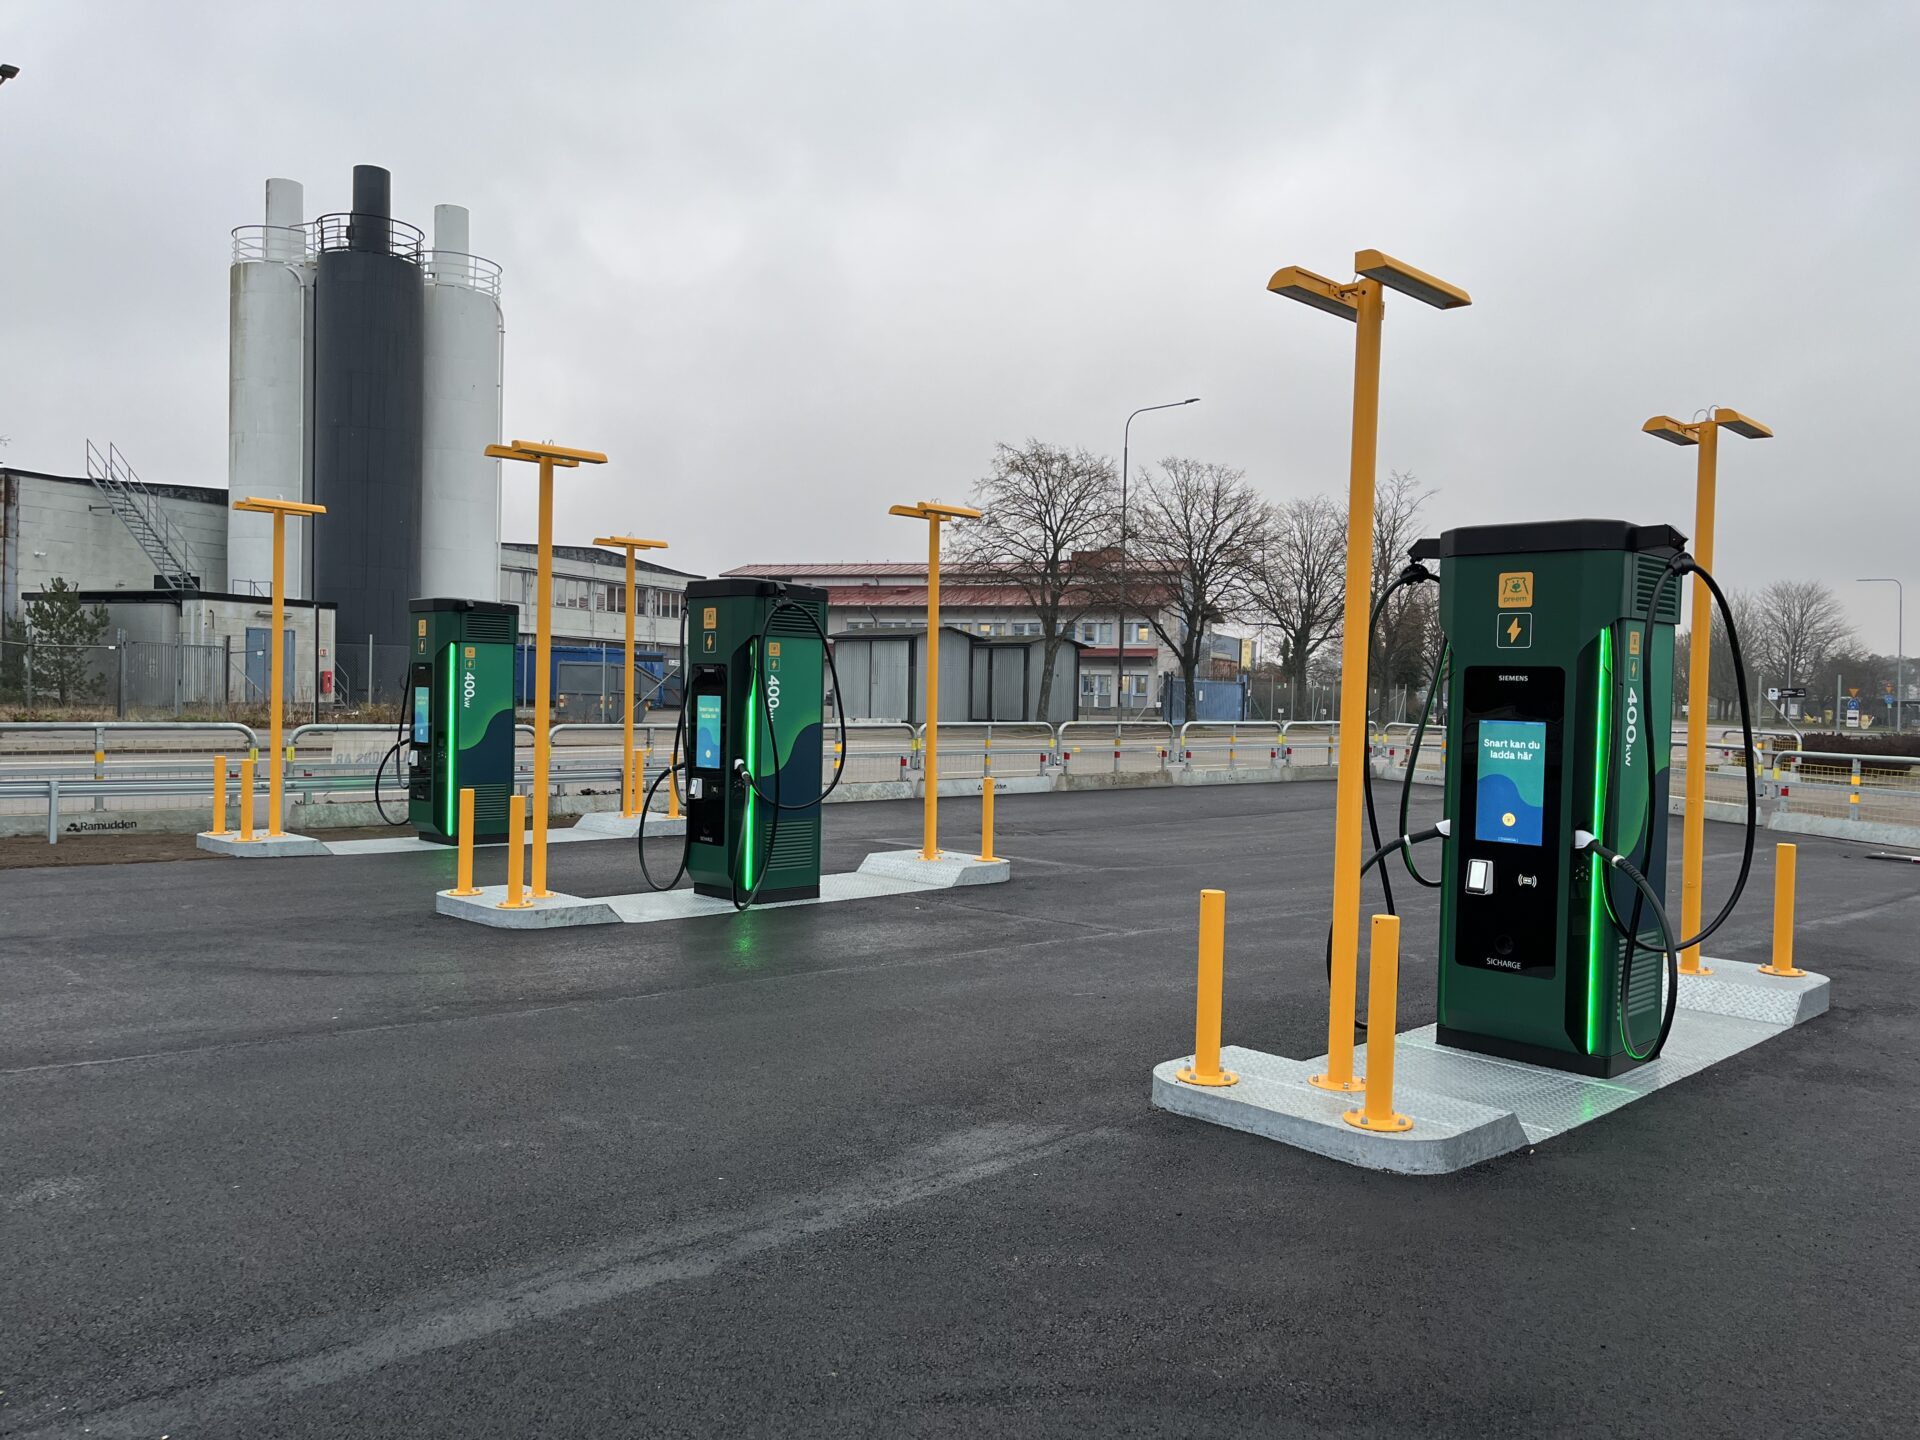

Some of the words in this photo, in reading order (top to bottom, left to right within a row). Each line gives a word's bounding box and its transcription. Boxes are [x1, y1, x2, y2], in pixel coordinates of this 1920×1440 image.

[1484, 739, 1508, 748] Snart
[1510, 740, 1526, 749] kan
[1528, 741, 1540, 749] du
[1490, 750, 1515, 760] ladda
[1517, 751, 1533, 761] här
[80, 820, 137, 831] Ramudden
[1486, 957, 1522, 969] SICHARGE
